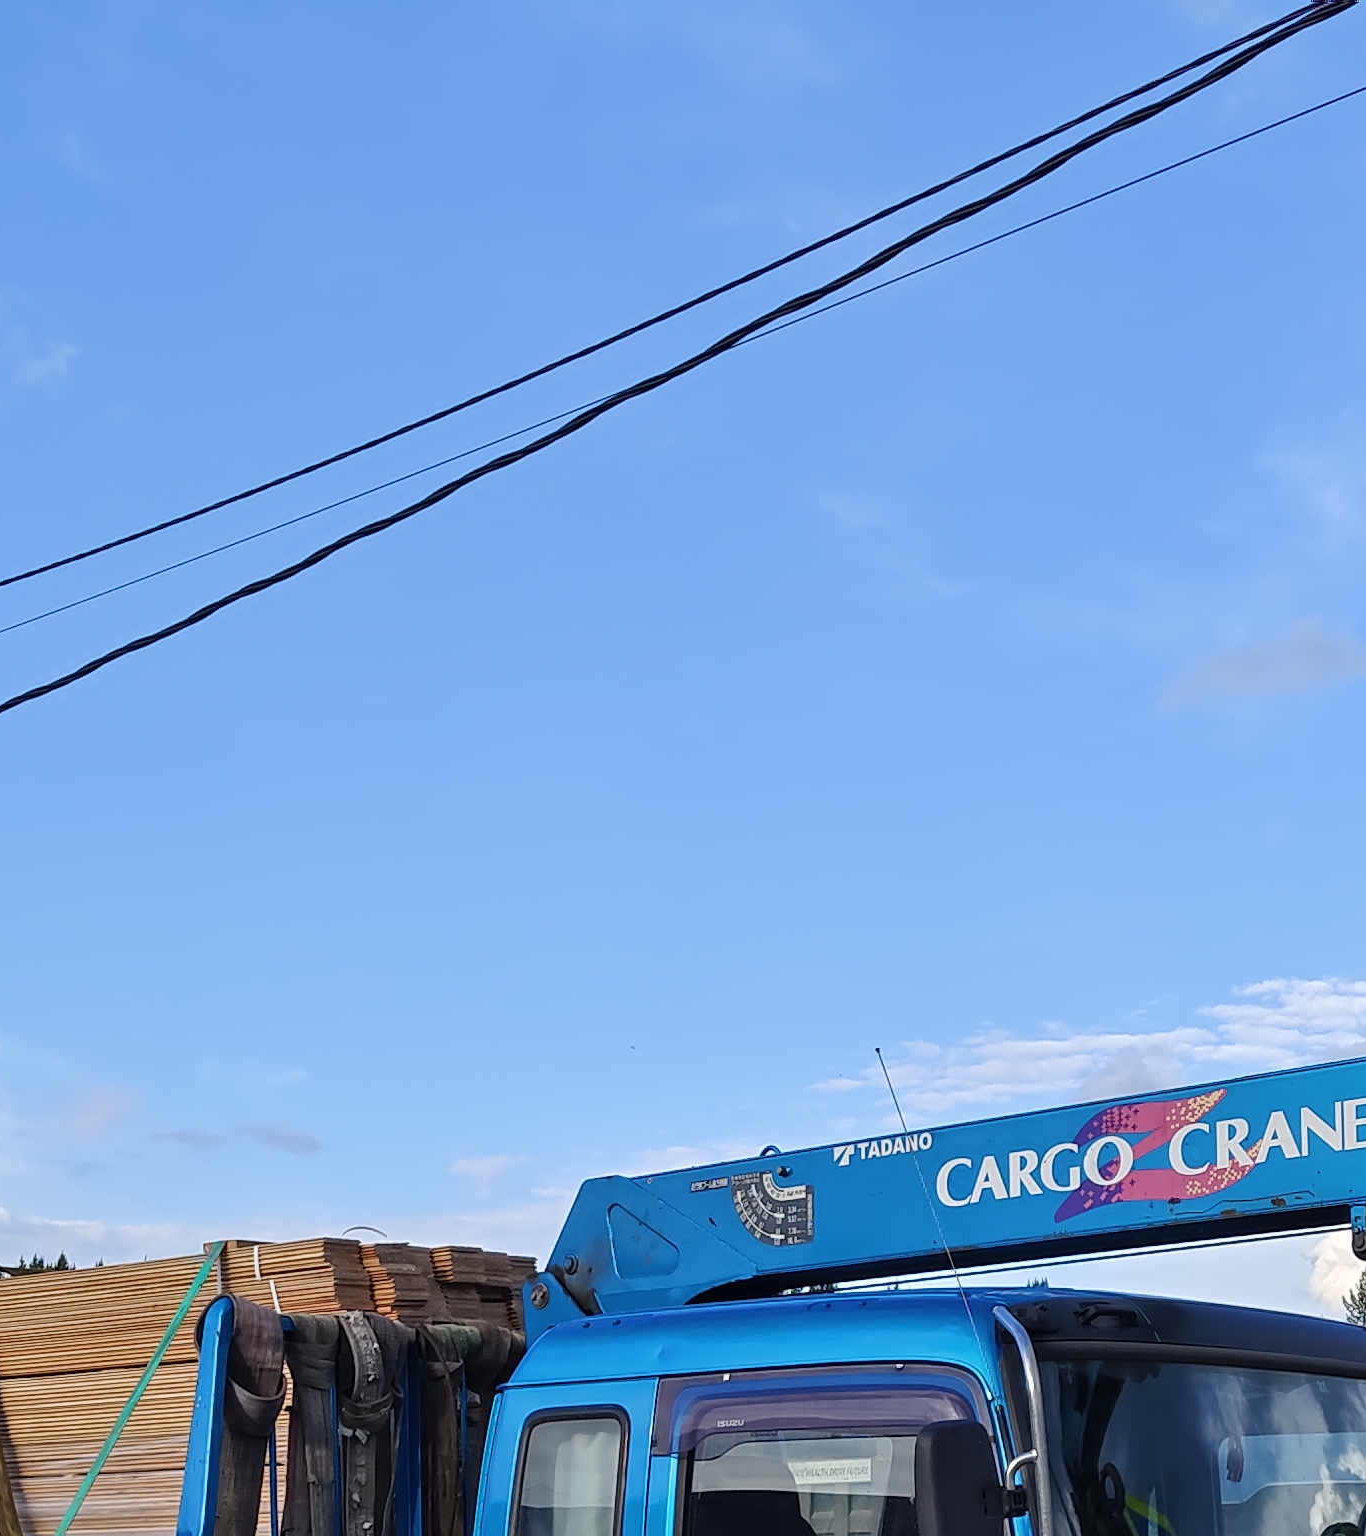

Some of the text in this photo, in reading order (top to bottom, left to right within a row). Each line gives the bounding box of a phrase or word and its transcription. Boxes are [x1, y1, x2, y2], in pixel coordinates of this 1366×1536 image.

[856, 1131, 933, 1160] TADANO
[935, 1135, 1134, 1208] CARGO
[716, 1419, 745, 1428] ISUZU
